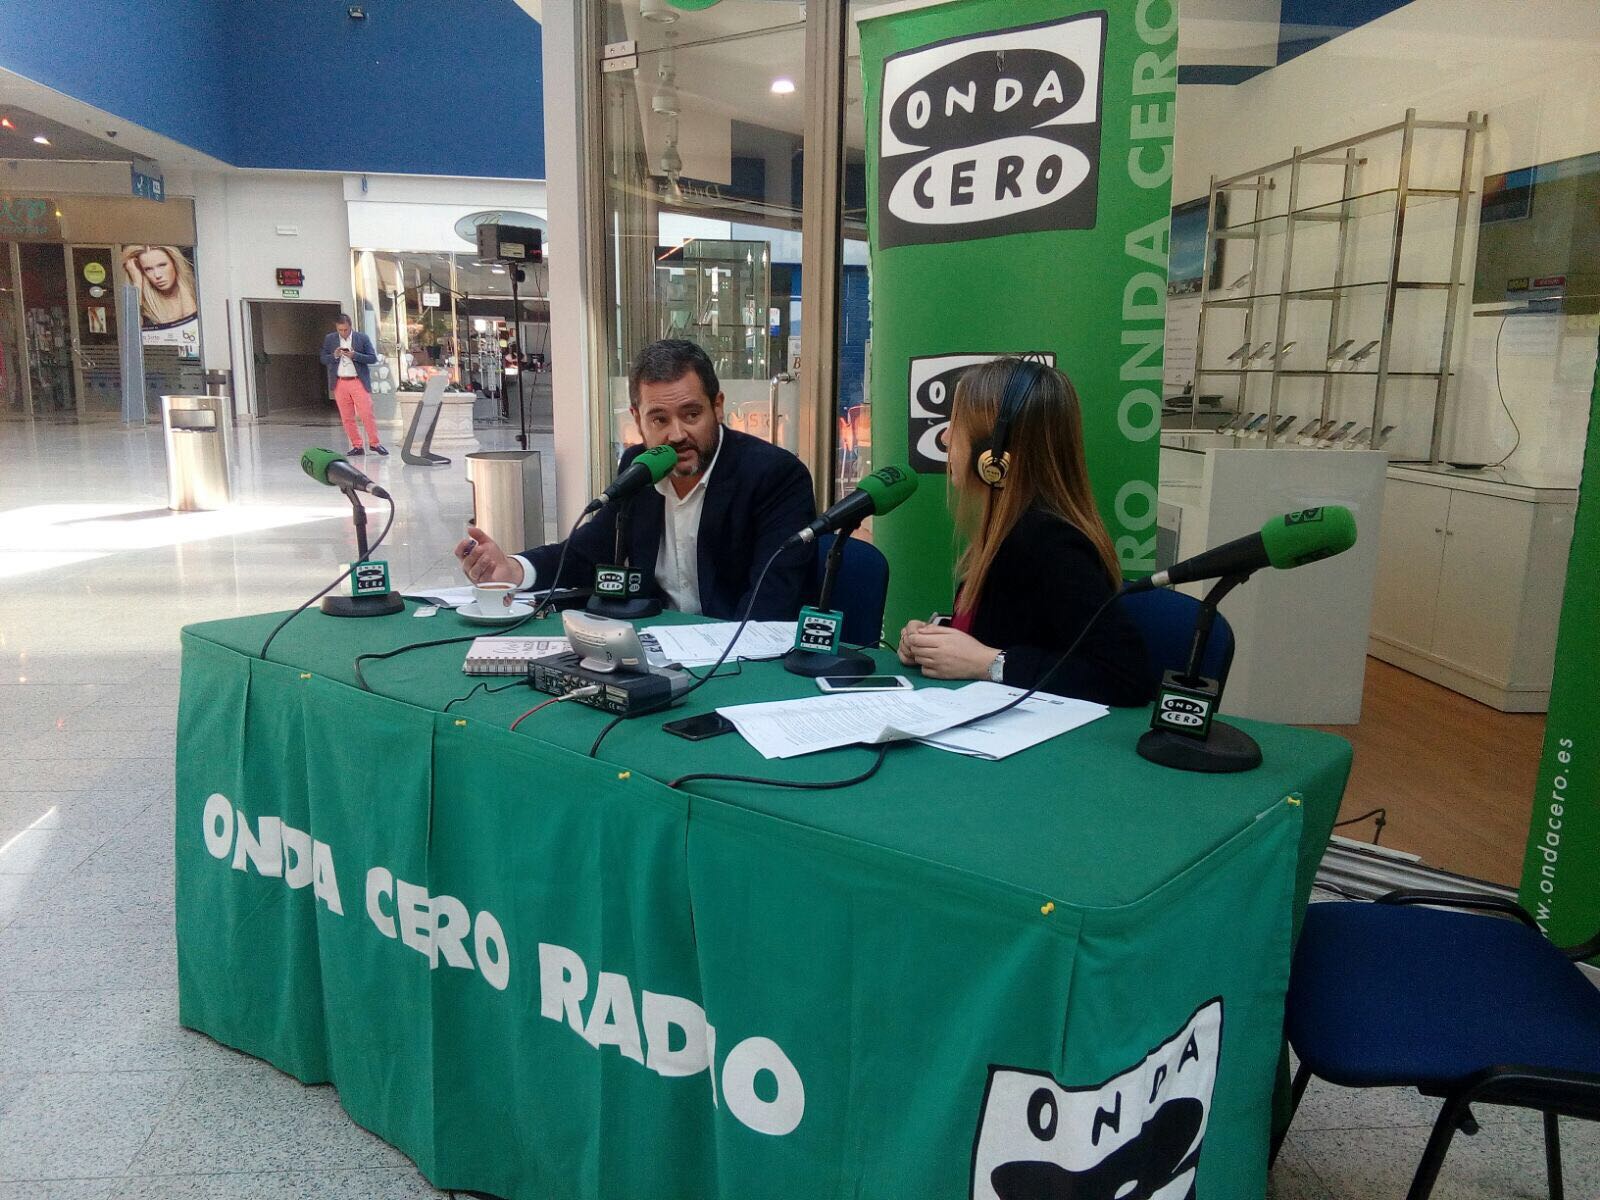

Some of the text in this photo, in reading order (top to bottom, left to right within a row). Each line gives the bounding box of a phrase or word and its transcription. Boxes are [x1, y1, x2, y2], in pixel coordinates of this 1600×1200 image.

[906, 70, 1064, 129] ONDA
[913, 154, 1063, 209] CERO
[1114, 0, 1179, 575] RO ONDA CERO
[802, 634, 830, 645] CERO
[1167, 700, 1201, 712] ONDA
[1167, 712, 1198, 724] CERO
[203, 793, 345, 917] ONDA
[366, 867, 511, 991] CERO
[1027, 1027, 1199, 1147] ONDA
